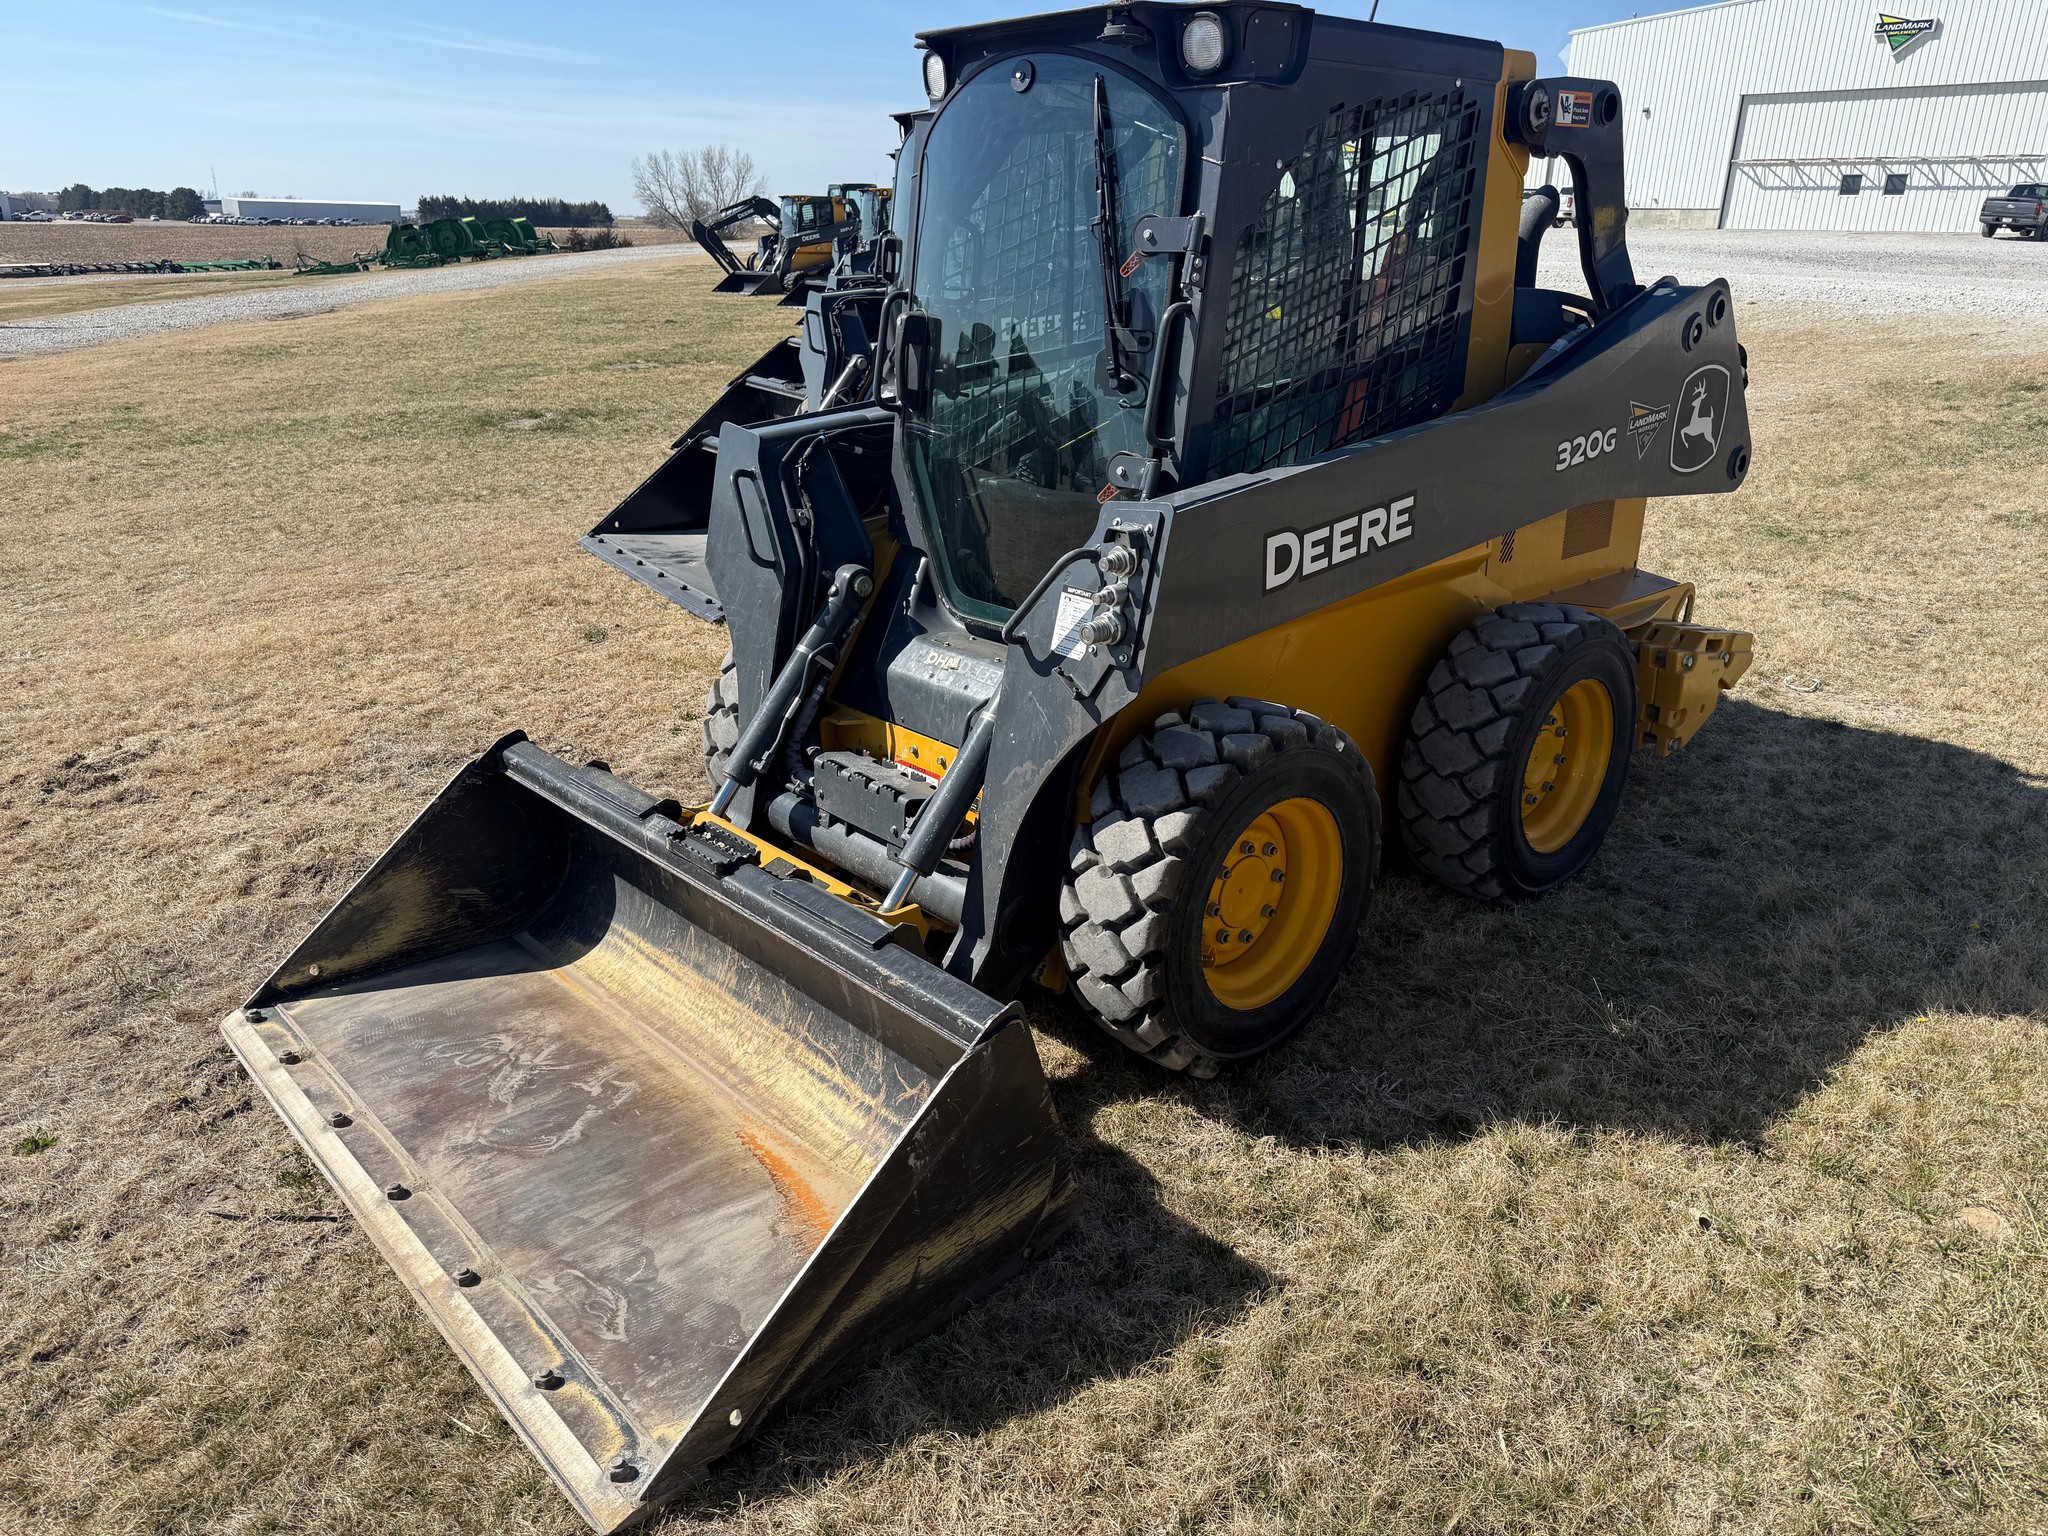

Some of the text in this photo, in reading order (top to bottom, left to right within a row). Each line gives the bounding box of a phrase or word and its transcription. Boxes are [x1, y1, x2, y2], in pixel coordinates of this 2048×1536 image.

[1876, 21, 1931, 32] LANDMARK
[801, 233, 821, 243] DEERE
[1629, 410, 1668, 430] LANDMARK
[1637, 421, 1660, 434] WORKSITE
[1555, 427, 1617, 472] 320G
[1265, 495, 1415, 590] DEERE
[1067, 586, 1093, 598] IMPORTANT
